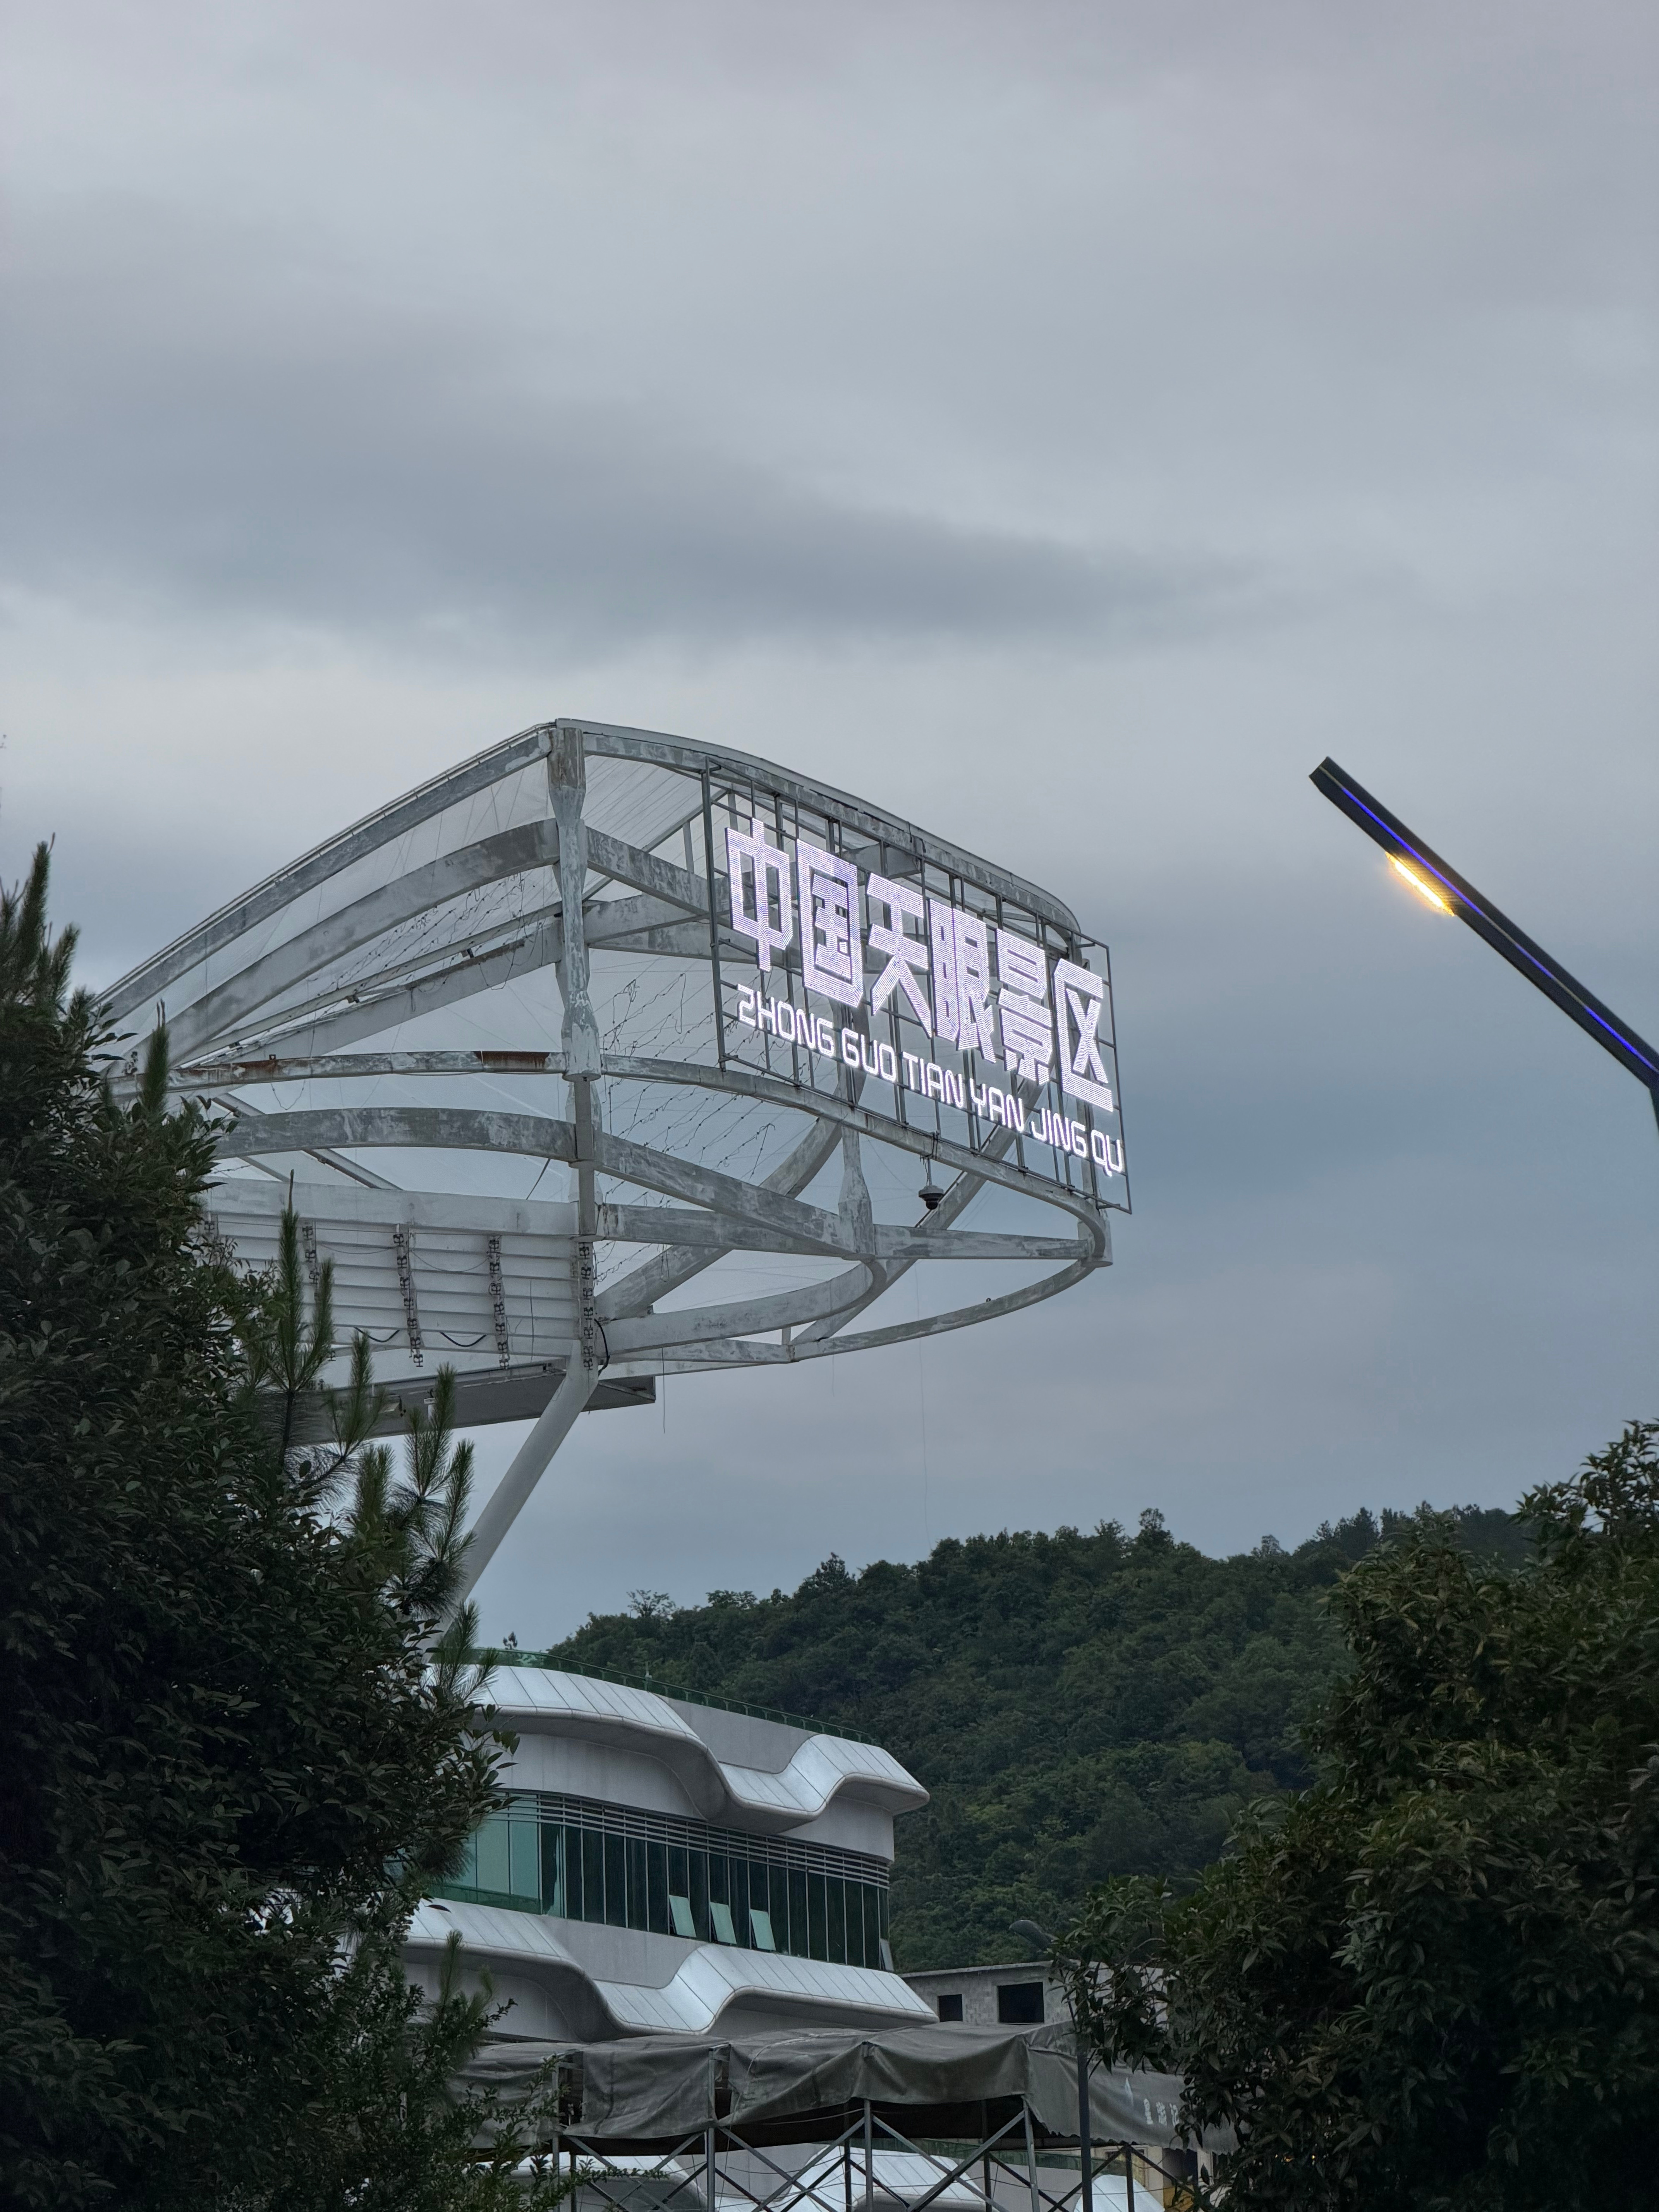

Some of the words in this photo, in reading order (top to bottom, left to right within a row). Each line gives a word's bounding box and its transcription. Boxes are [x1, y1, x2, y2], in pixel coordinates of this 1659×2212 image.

[725, 818, 1113, 1111] 中国天眼景区
[738, 984, 835, 1057] ZHONG
[842, 1027, 896, 1082] GUO
[902, 1051, 963, 1108] TIAN
[970, 1078, 1024, 1132] YAN
[1031, 1107, 1087, 1158] JING
[1091, 1129, 1123, 1177] QU
